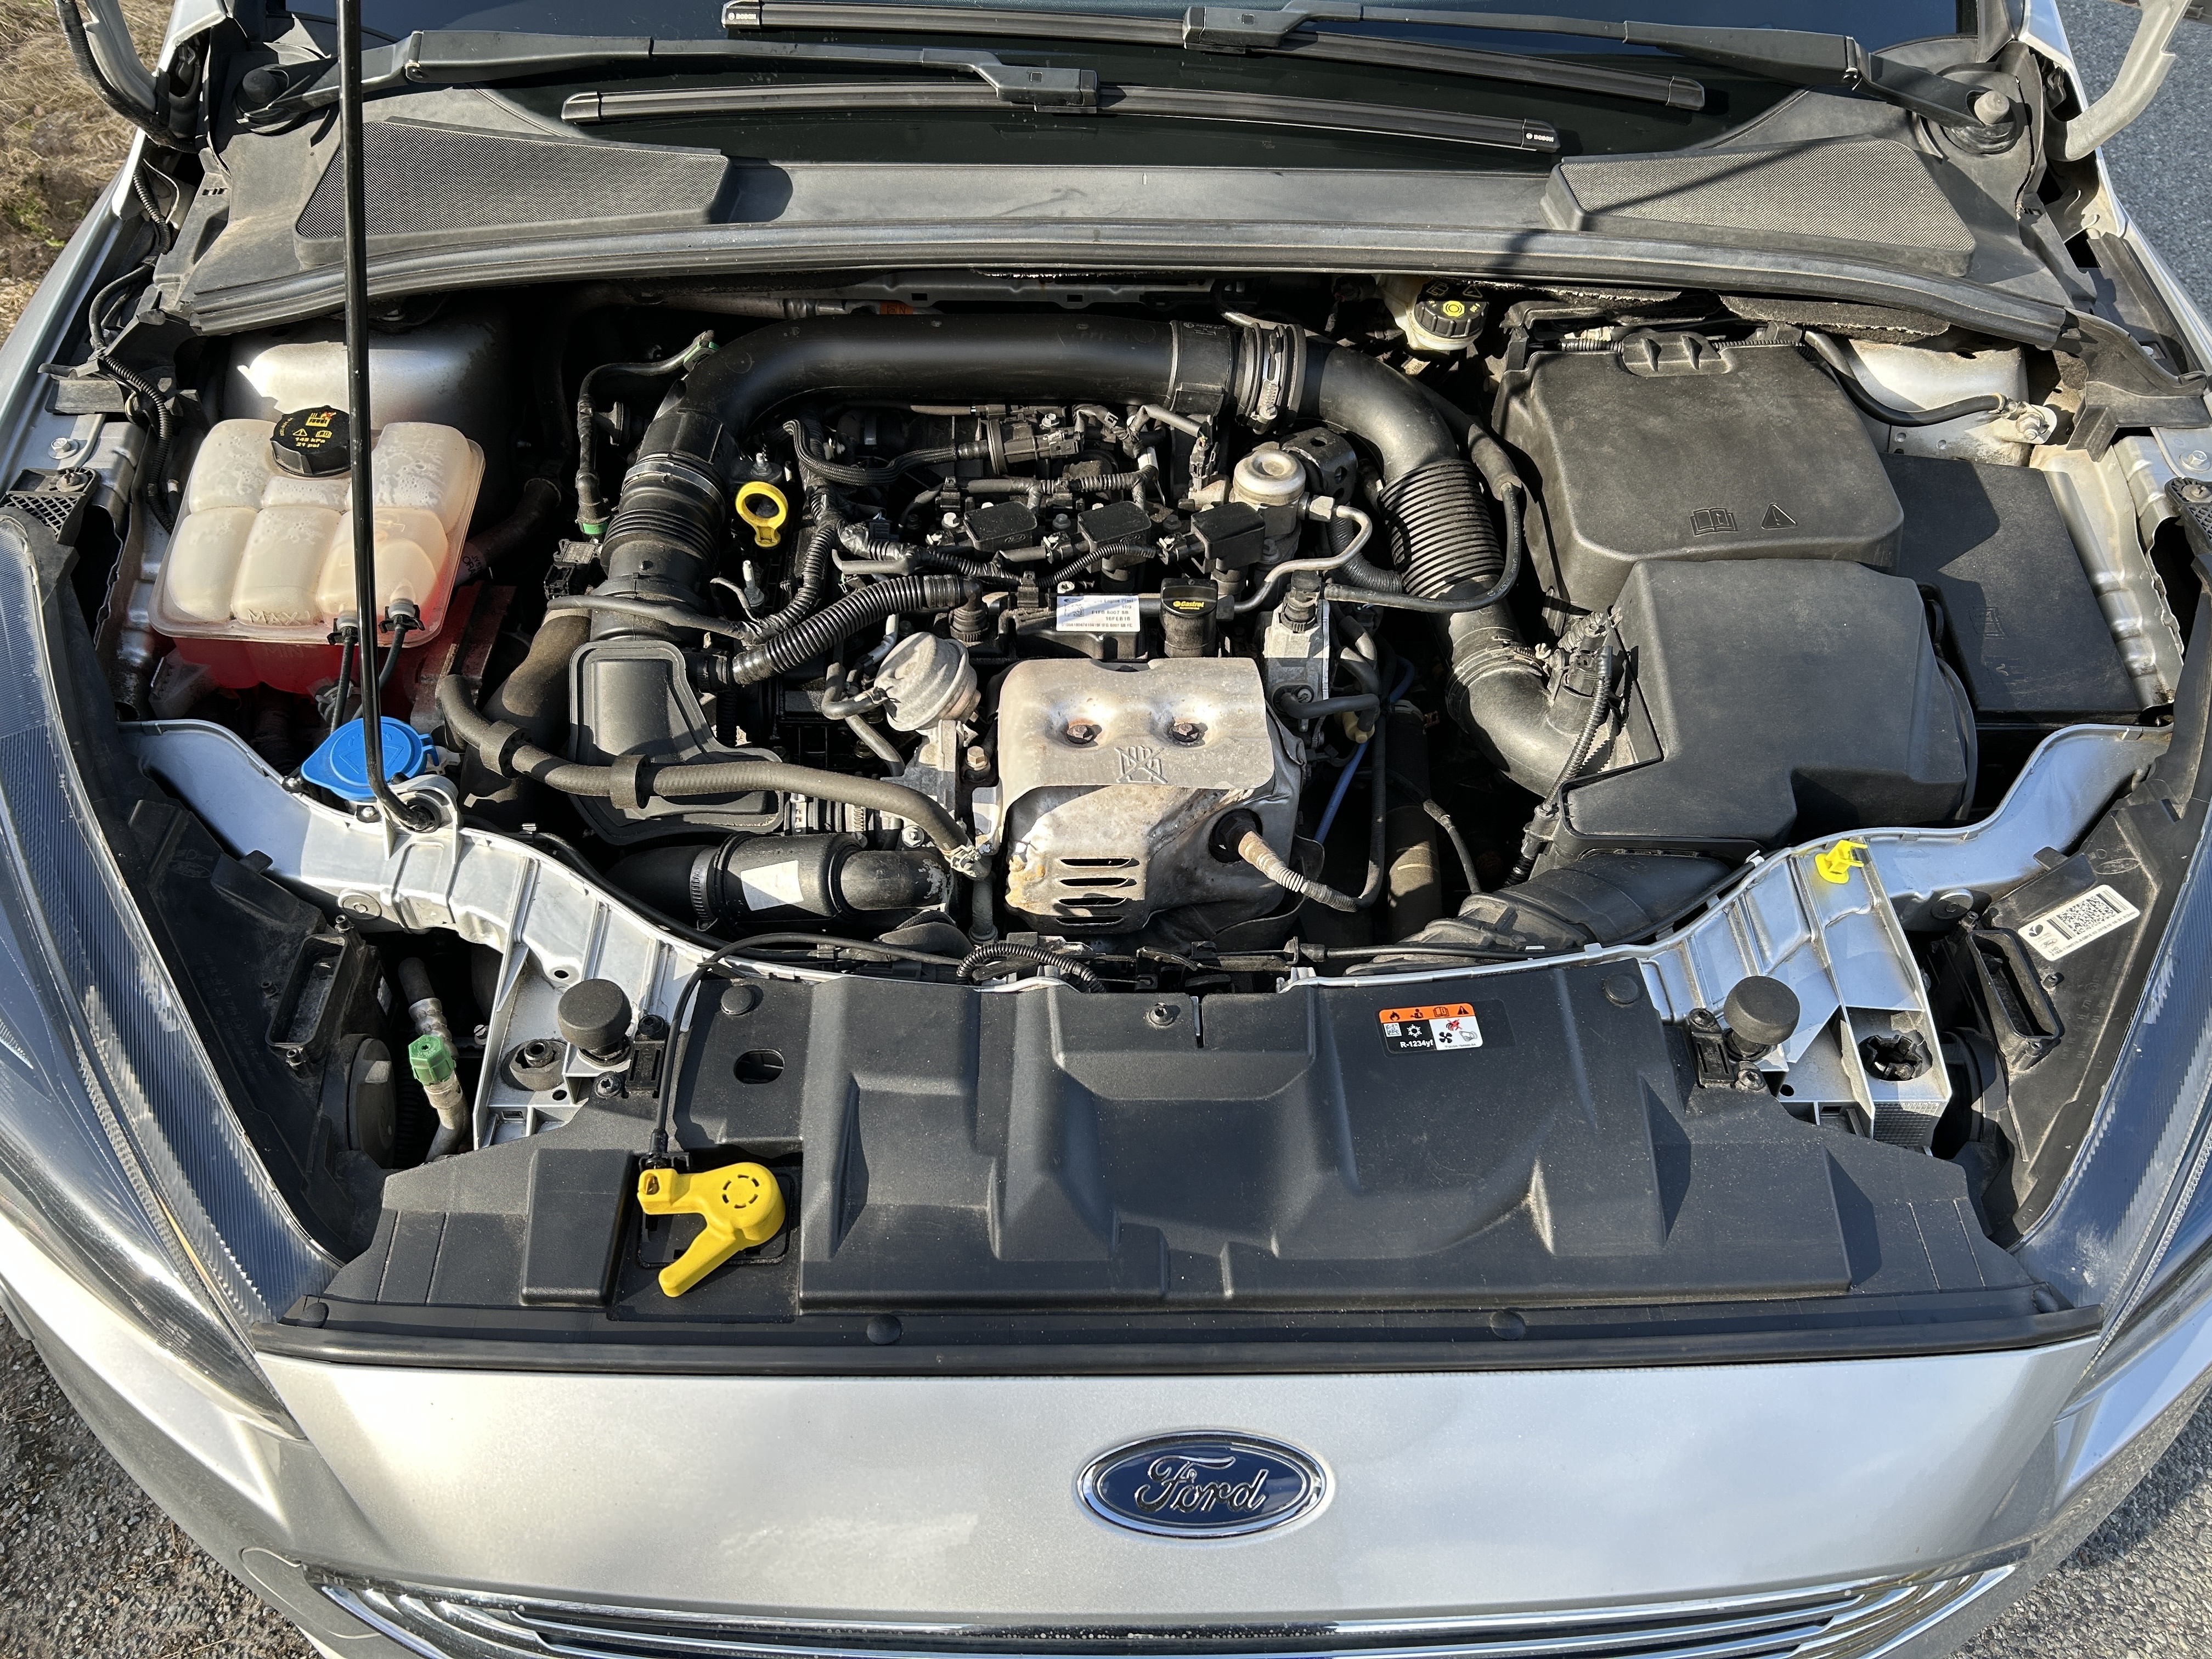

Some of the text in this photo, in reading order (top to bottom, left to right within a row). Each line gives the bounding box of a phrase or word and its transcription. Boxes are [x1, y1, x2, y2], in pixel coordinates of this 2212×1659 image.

[247, 608, 302, 627] MAX
[1400, 1039, 1434, 1048] R-1234yf
[1133, 1454, 1269, 1514] Ford
